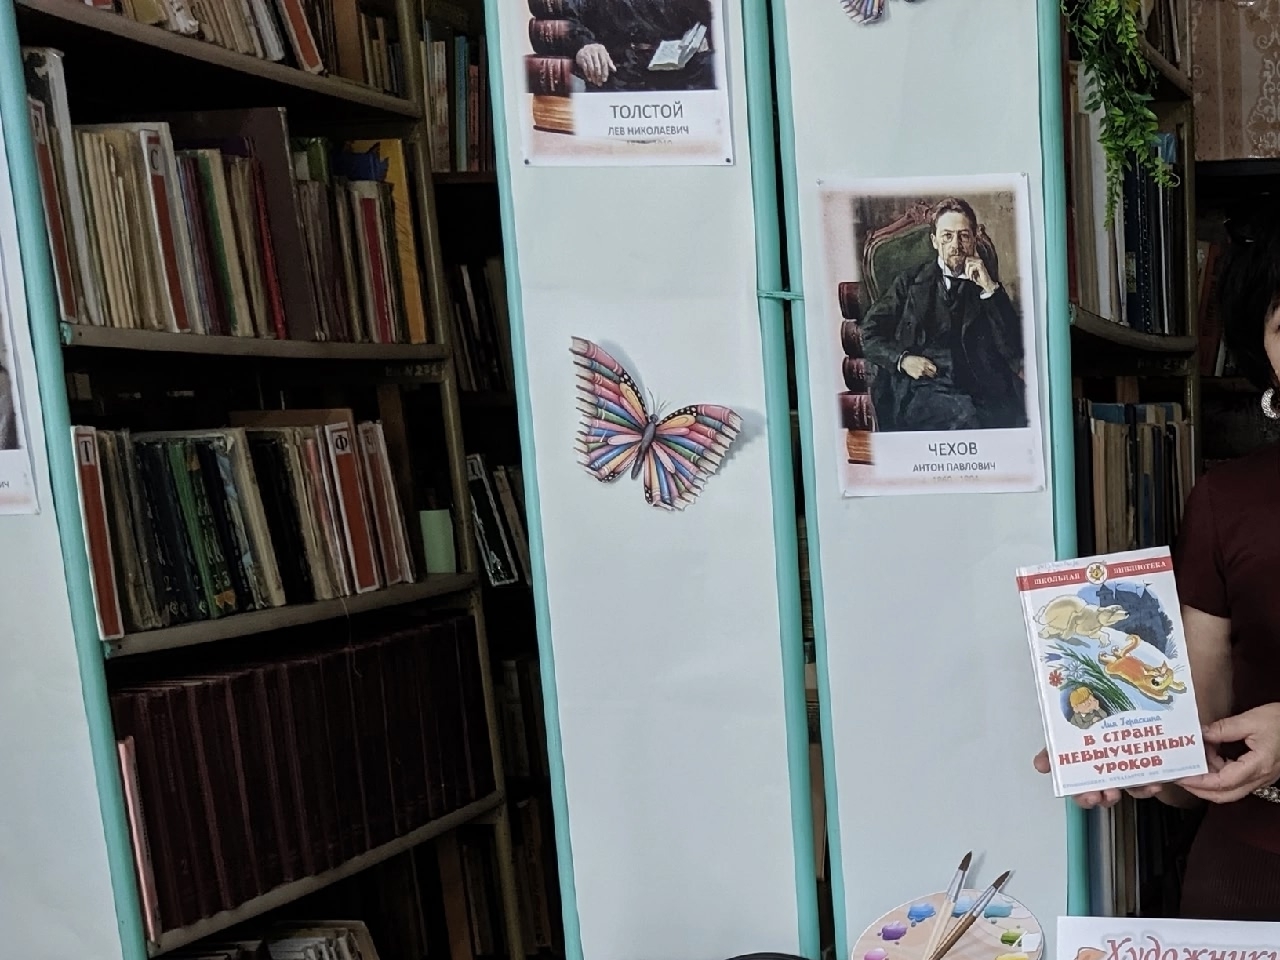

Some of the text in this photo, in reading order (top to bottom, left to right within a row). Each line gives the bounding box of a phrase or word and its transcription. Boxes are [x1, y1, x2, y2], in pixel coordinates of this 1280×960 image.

[609, 100, 683, 118] ТОЛСТОЙ
[608, 125, 689, 136] ЛЕВ НИКОЛАЕВИЧ
[928, 442, 978, 456] ЧЕХОВ
[913, 461, 996, 472] АНТОН ПАВЛОВИЧ
[1034, 573, 1080, 585] ШКОЛЬНАЯ
[1083, 724, 1165, 746] В СТРАНЕ
[1058, 734, 1196, 766] НЕВЫУЧЕННЫХ
[1093, 755, 1163, 775] УРОКОВ
